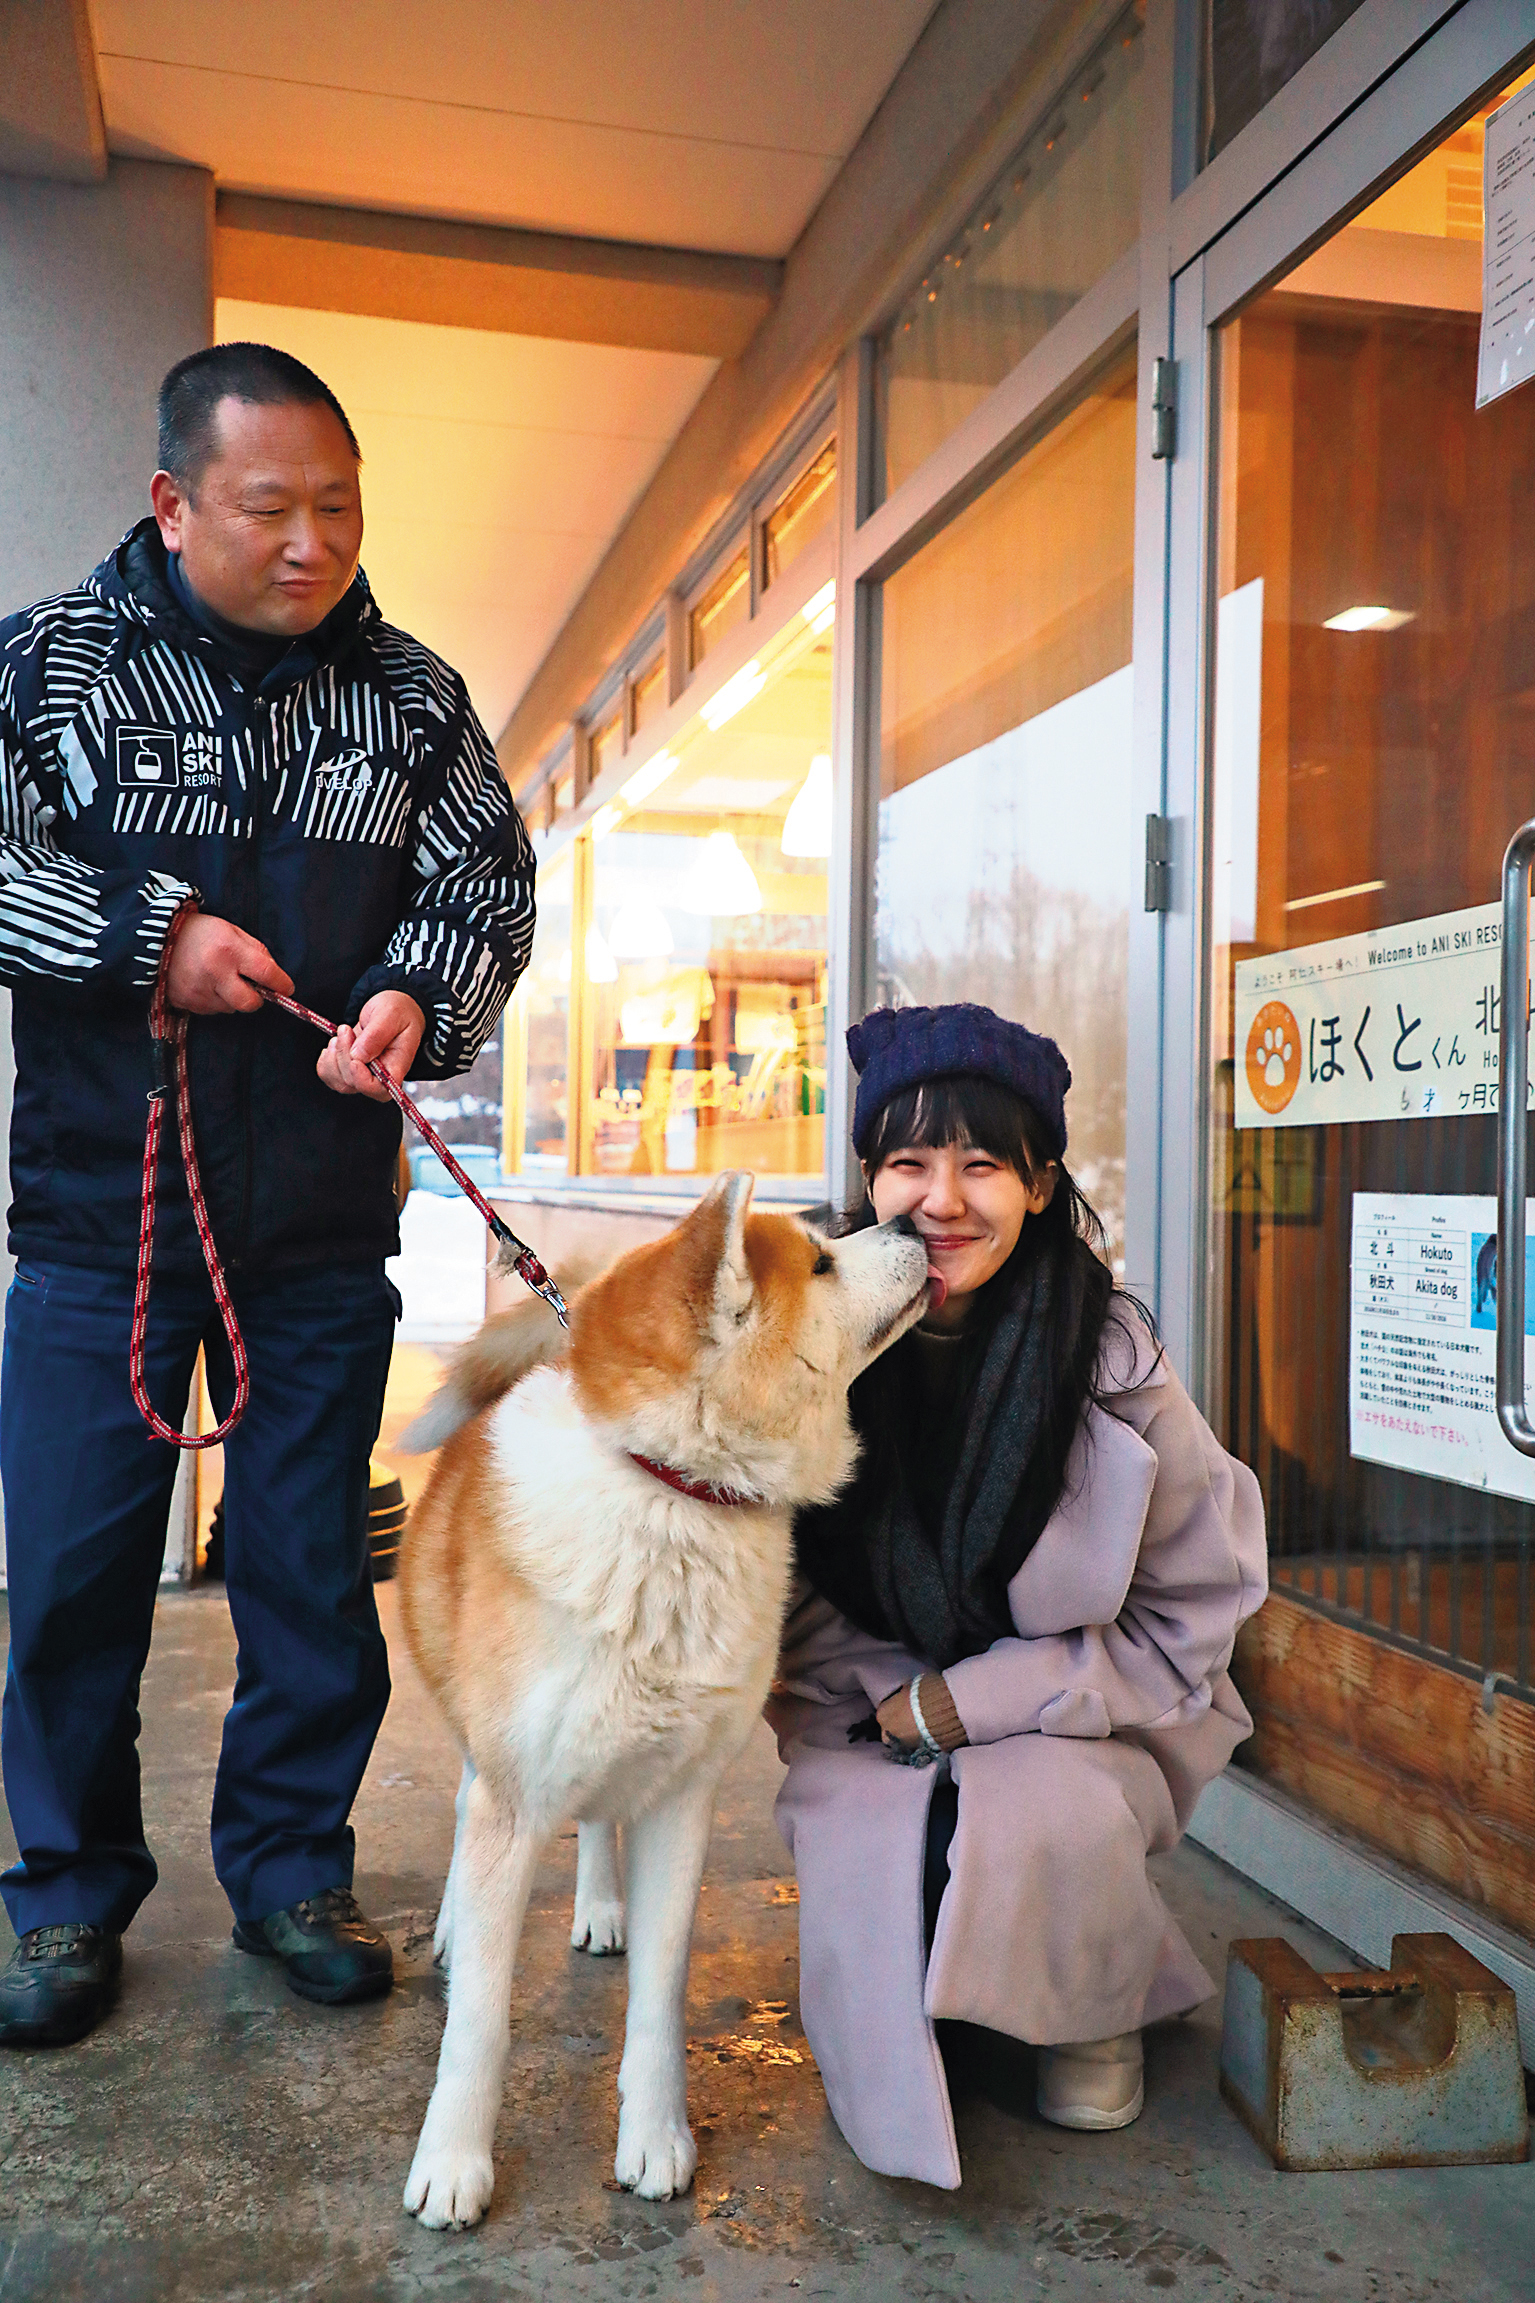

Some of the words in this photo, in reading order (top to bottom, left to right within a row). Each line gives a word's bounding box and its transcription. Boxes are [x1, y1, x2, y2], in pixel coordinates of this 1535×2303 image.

[182, 731, 222, 753] ANI
[183, 752, 222, 775] SKI
[184, 773, 222, 788] RESORT
[1368, 947, 1413, 965] Welcome
[1417, 941, 1427, 957] to
[1431, 935, 1450, 954] ANI
[1454, 931, 1471, 949] SKI
[1255, 972, 1283, 988] ようこそ
[1421, 1245, 1453, 1261] Hokuto
[1369, 1274, 1394, 1290] 秋田犬
[1415, 1279, 1438, 1295] Akita
[1440, 1282, 1458, 1300] dog
